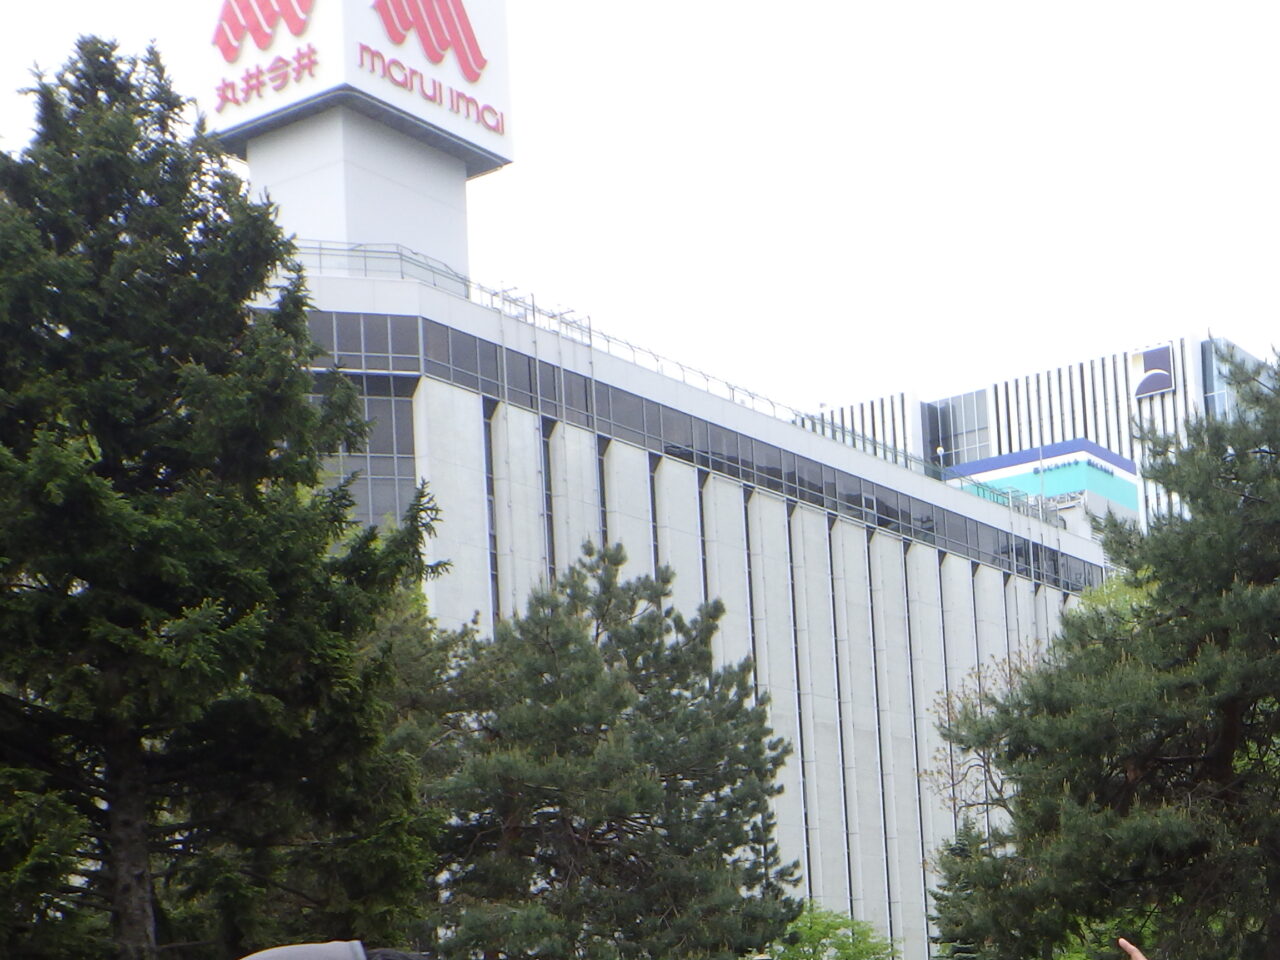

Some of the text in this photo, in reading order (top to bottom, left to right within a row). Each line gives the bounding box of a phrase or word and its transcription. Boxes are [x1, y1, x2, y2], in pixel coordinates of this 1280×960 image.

[215, 43, 319, 113] 丸井今井
[358, 42, 505, 136] marui imai
